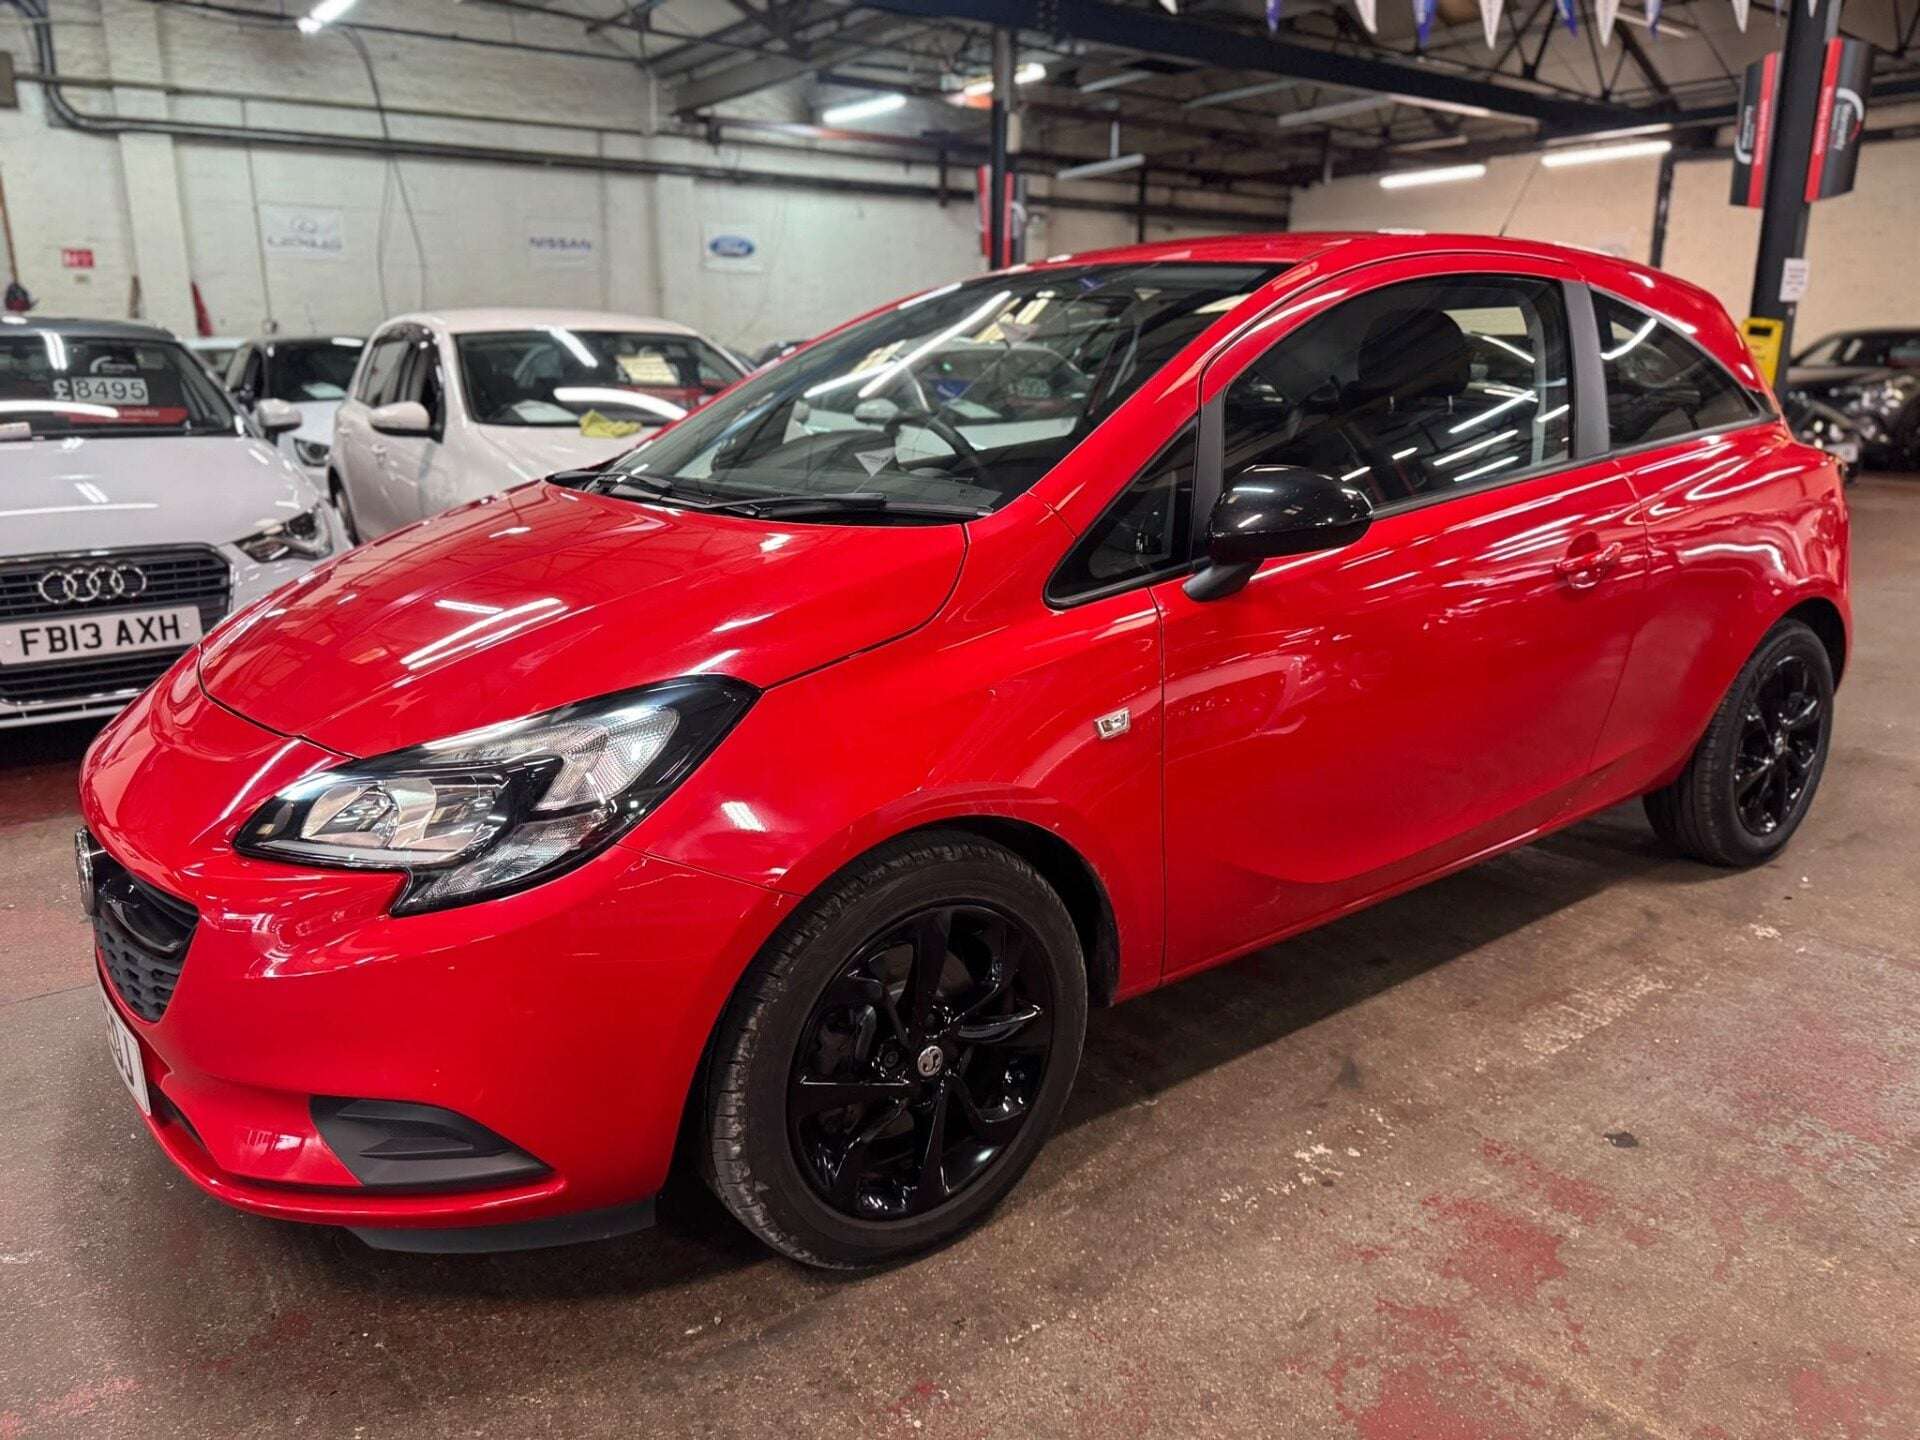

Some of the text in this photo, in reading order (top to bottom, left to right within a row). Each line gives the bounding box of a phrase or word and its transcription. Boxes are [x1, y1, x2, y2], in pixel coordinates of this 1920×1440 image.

[529, 237, 592, 250] NISSAN
[20, 614, 181, 656] FB13 AXH
